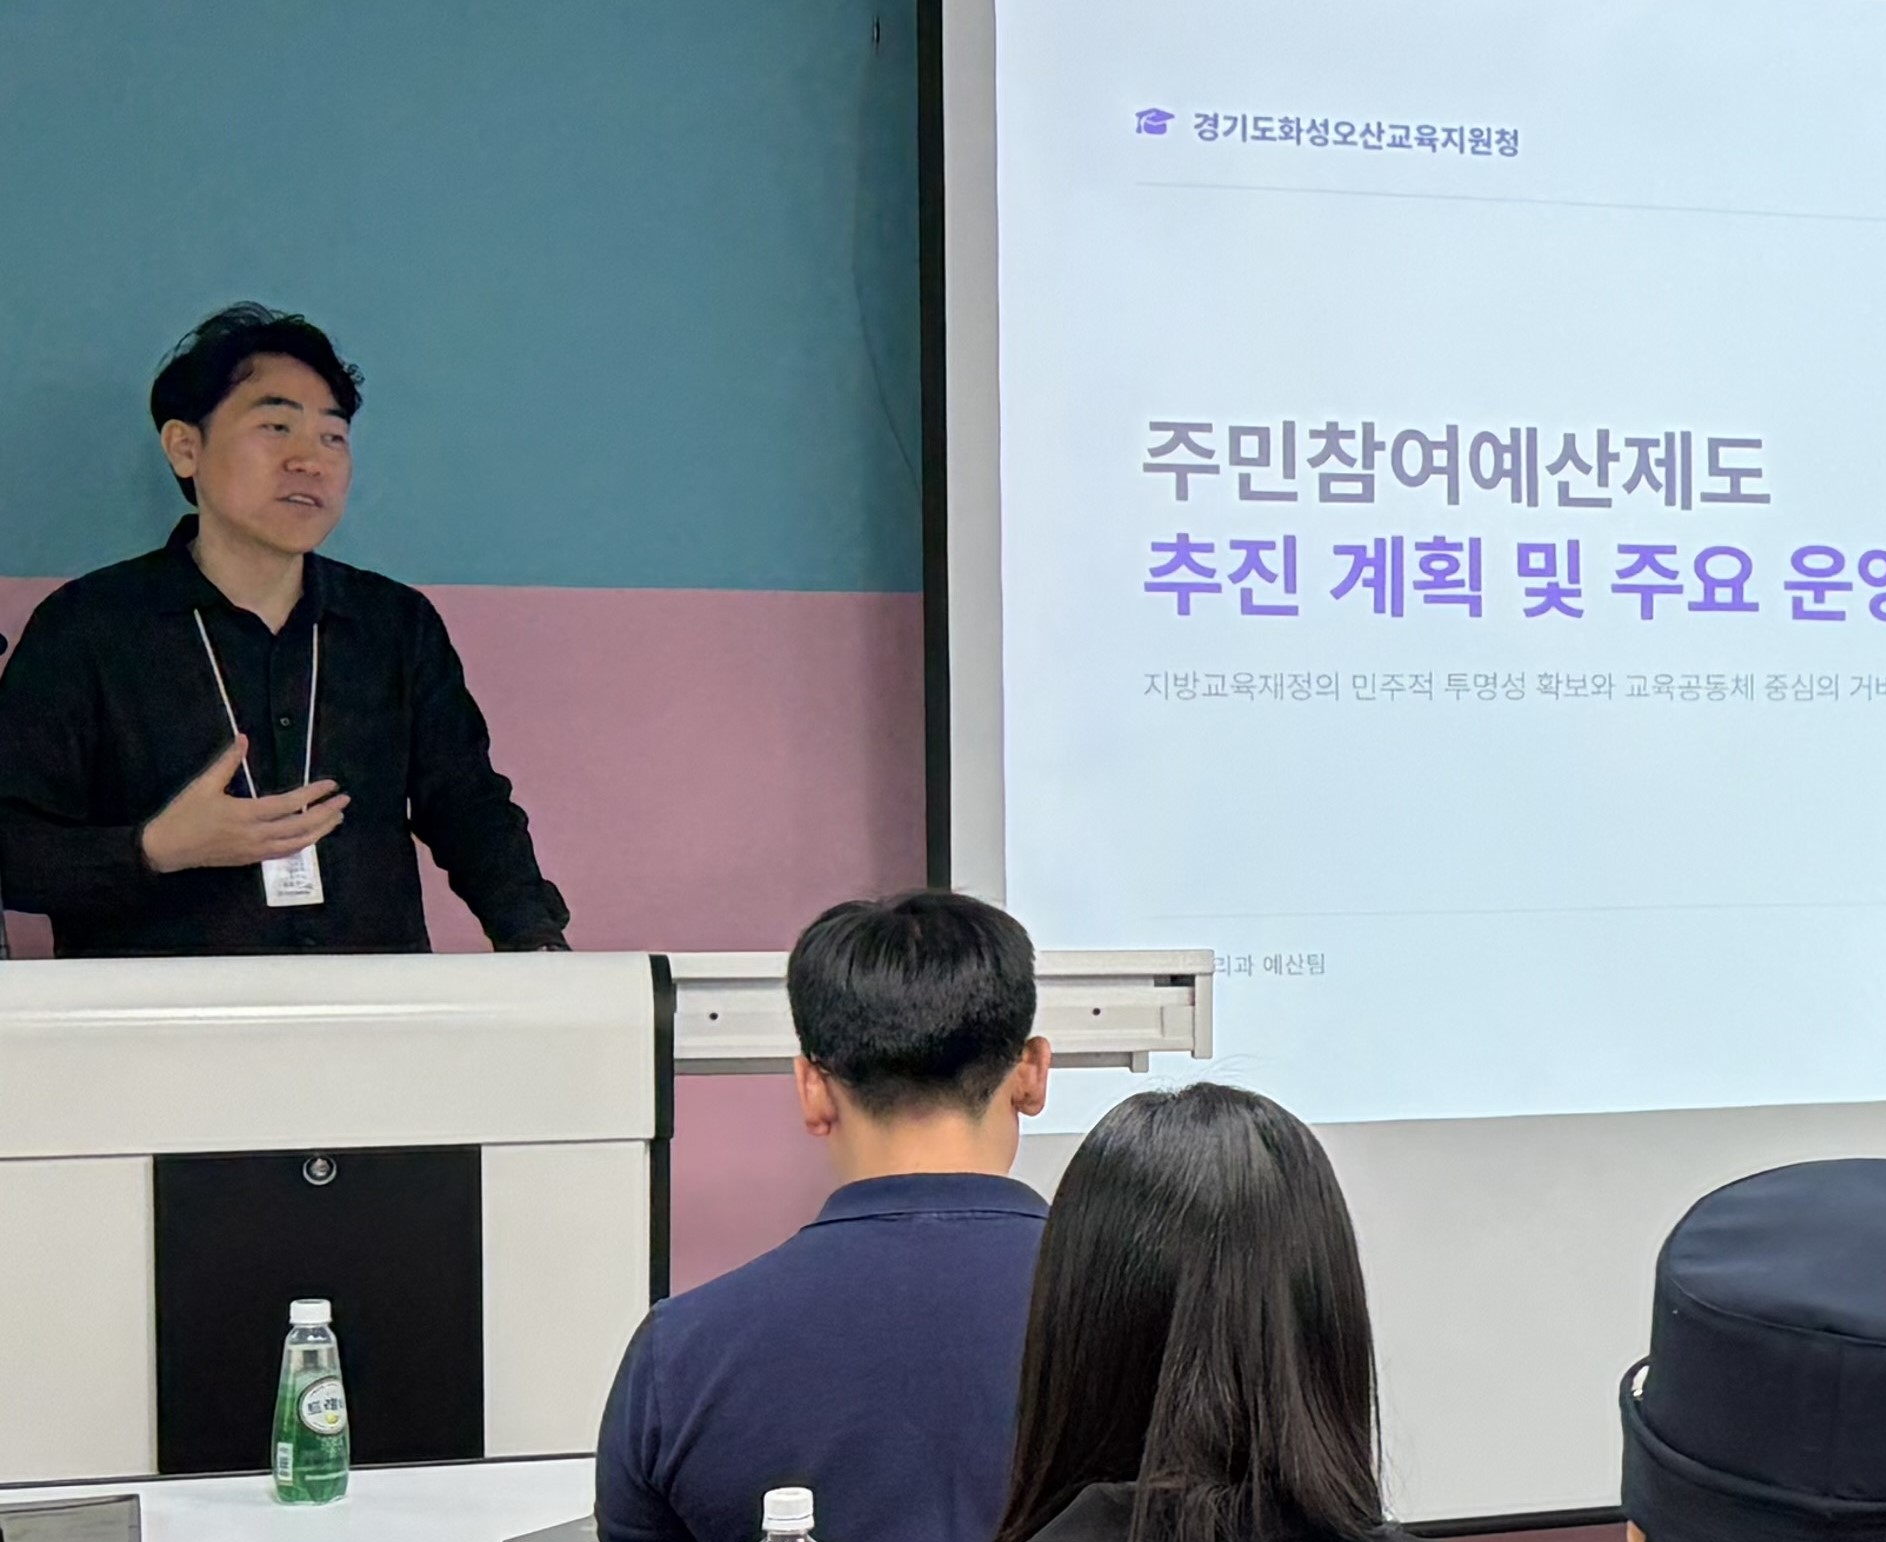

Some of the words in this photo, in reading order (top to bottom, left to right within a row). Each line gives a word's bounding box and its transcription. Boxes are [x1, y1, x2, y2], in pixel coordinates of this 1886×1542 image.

[1193, 112, 1519, 158] 경기도화성오산교육지원청
[1142, 419, 1772, 511] 주민참여예산제도
[1143, 532, 1300, 618] 추진
[1329, 534, 1483, 618] 계획
[1516, 538, 1585, 619] 및
[1610, 543, 1760, 621] 주요
[1143, 670, 1340, 702] 지방교육재정의
[1351, 671, 1433, 702] 민주적
[1444, 671, 1526, 702] 투명성
[1535, 671, 1616, 702] 확보와
[1625, 673, 1755, 702] 교육공동체
[1764, 673, 1840, 702] 중심의
[1213, 953, 1254, 977] 리과
[1263, 952, 1326, 976] 예산팀
